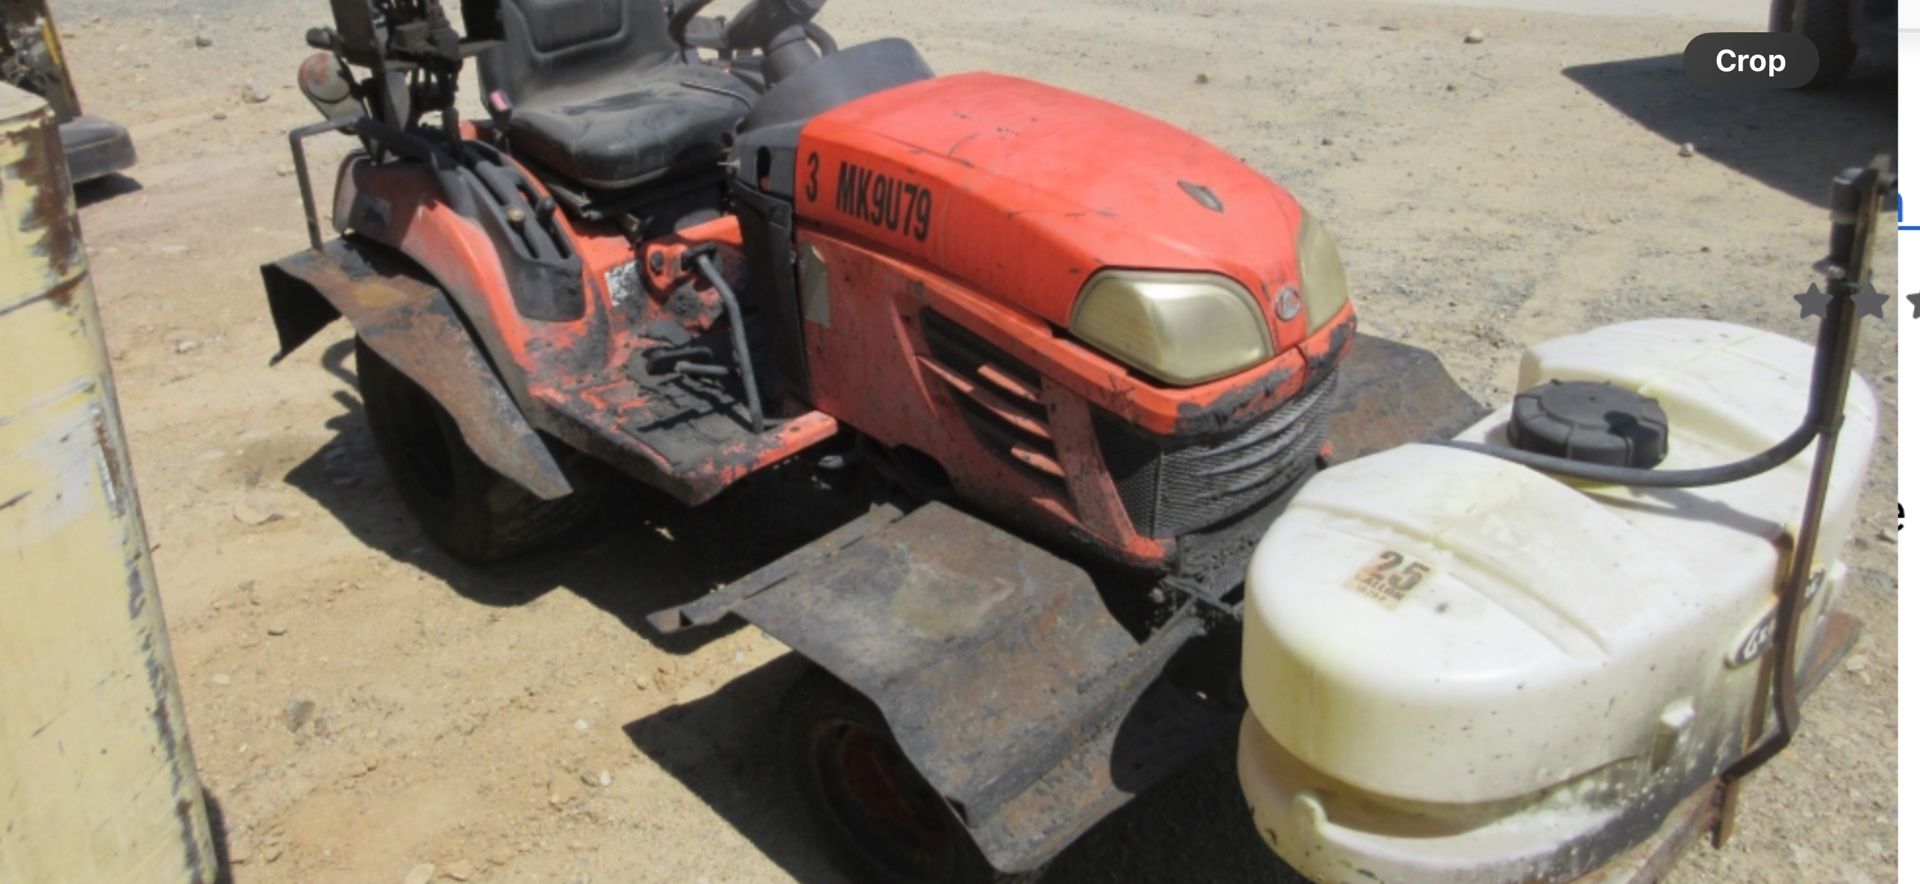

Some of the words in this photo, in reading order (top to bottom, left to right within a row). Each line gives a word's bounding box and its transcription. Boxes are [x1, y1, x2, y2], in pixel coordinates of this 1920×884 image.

[806, 152, 819, 203] 3
[836, 161, 932, 241] MK9U79
[1369, 549, 1430, 591] 25
